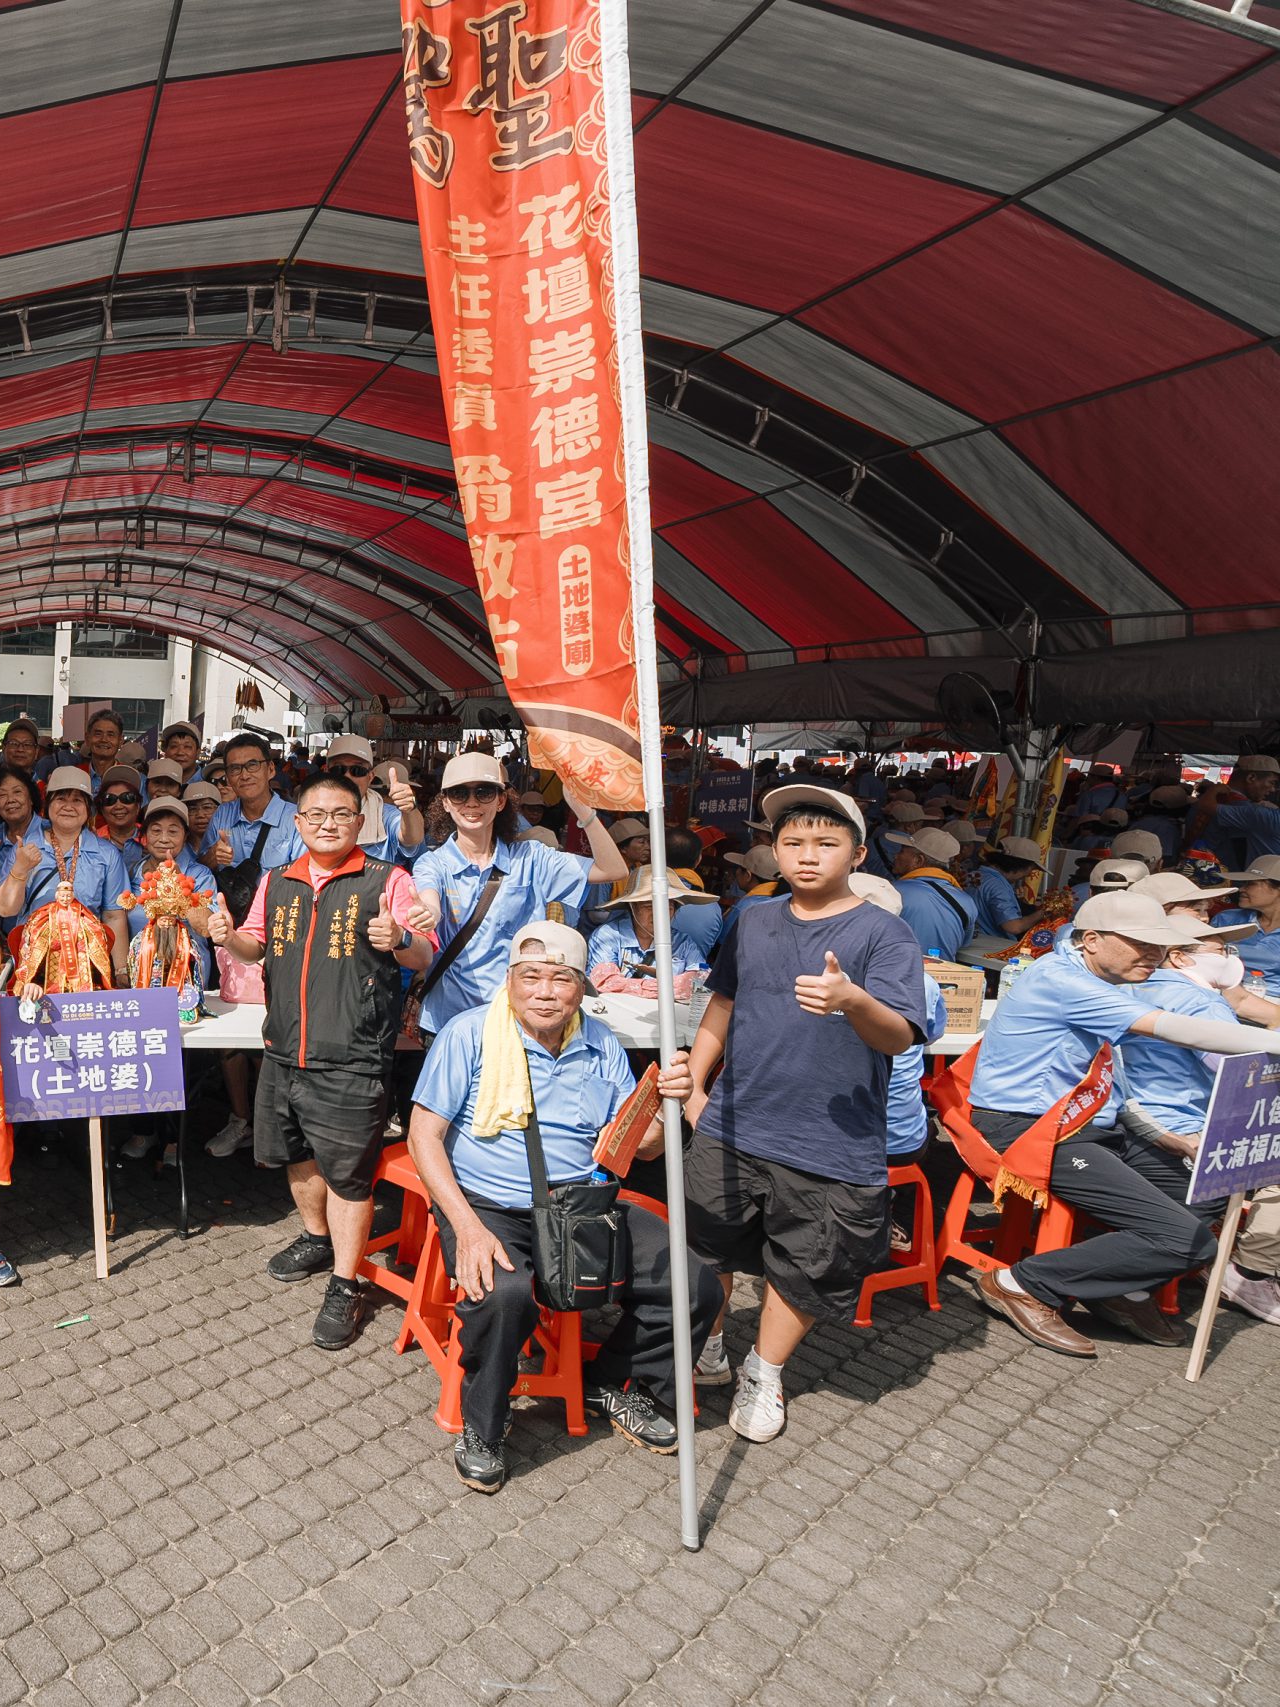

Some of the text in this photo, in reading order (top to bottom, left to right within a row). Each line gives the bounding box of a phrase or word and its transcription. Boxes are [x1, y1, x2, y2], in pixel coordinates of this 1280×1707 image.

[447, 215, 498, 432] 主任委員
[518, 181, 603, 540] 花壇崇德宮
[561, 555, 593, 667] 土地婆廟
[61, 1000, 140, 1014] 2025 土地公
[10, 1028, 169, 1065] 花壇崇德宮
[31, 1062, 154, 1099] (土地婆)
